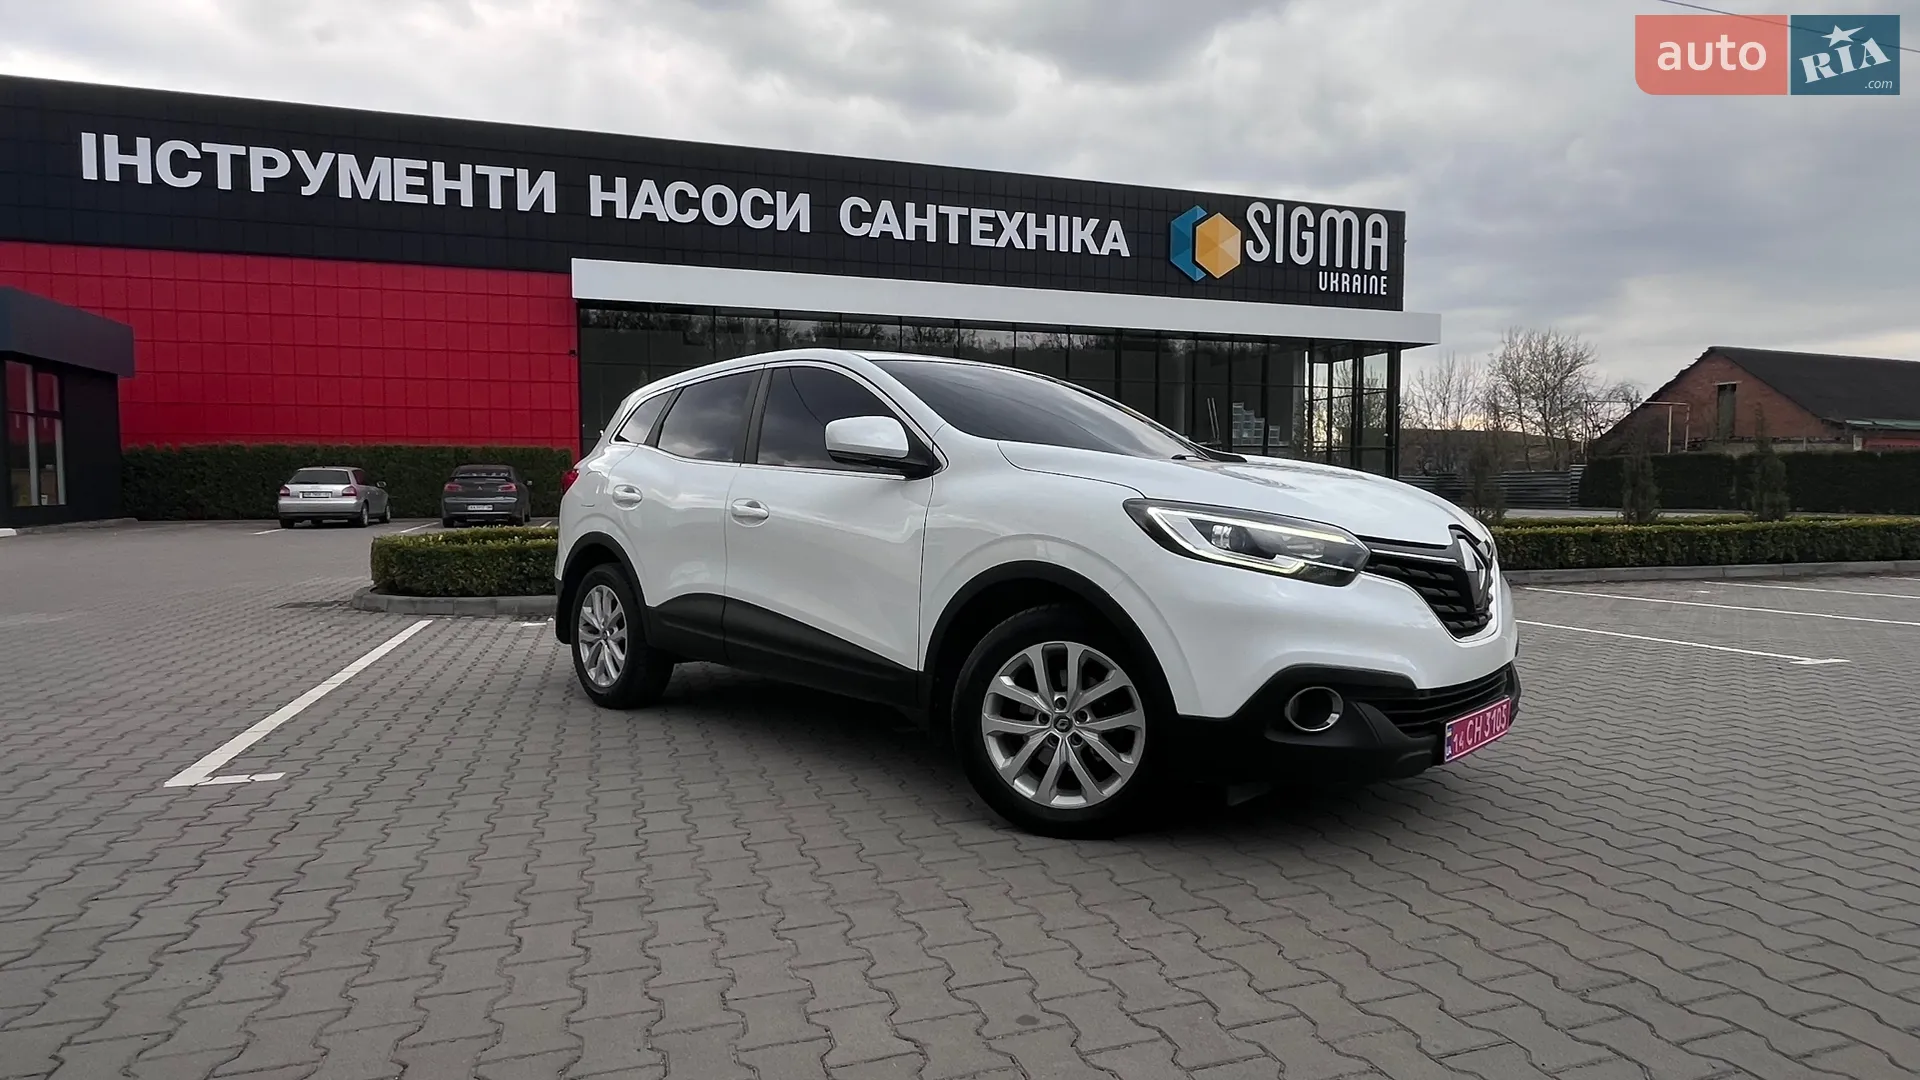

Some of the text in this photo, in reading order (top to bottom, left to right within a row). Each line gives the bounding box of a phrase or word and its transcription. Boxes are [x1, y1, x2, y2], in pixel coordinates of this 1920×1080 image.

[81, 132, 1131, 257] ІНСТРУМЕНТИ НАСОСИ САНТЕХНІКА
[1245, 201, 1389, 272] SIGMA
[1318, 271, 1388, 296] UKRAINE
